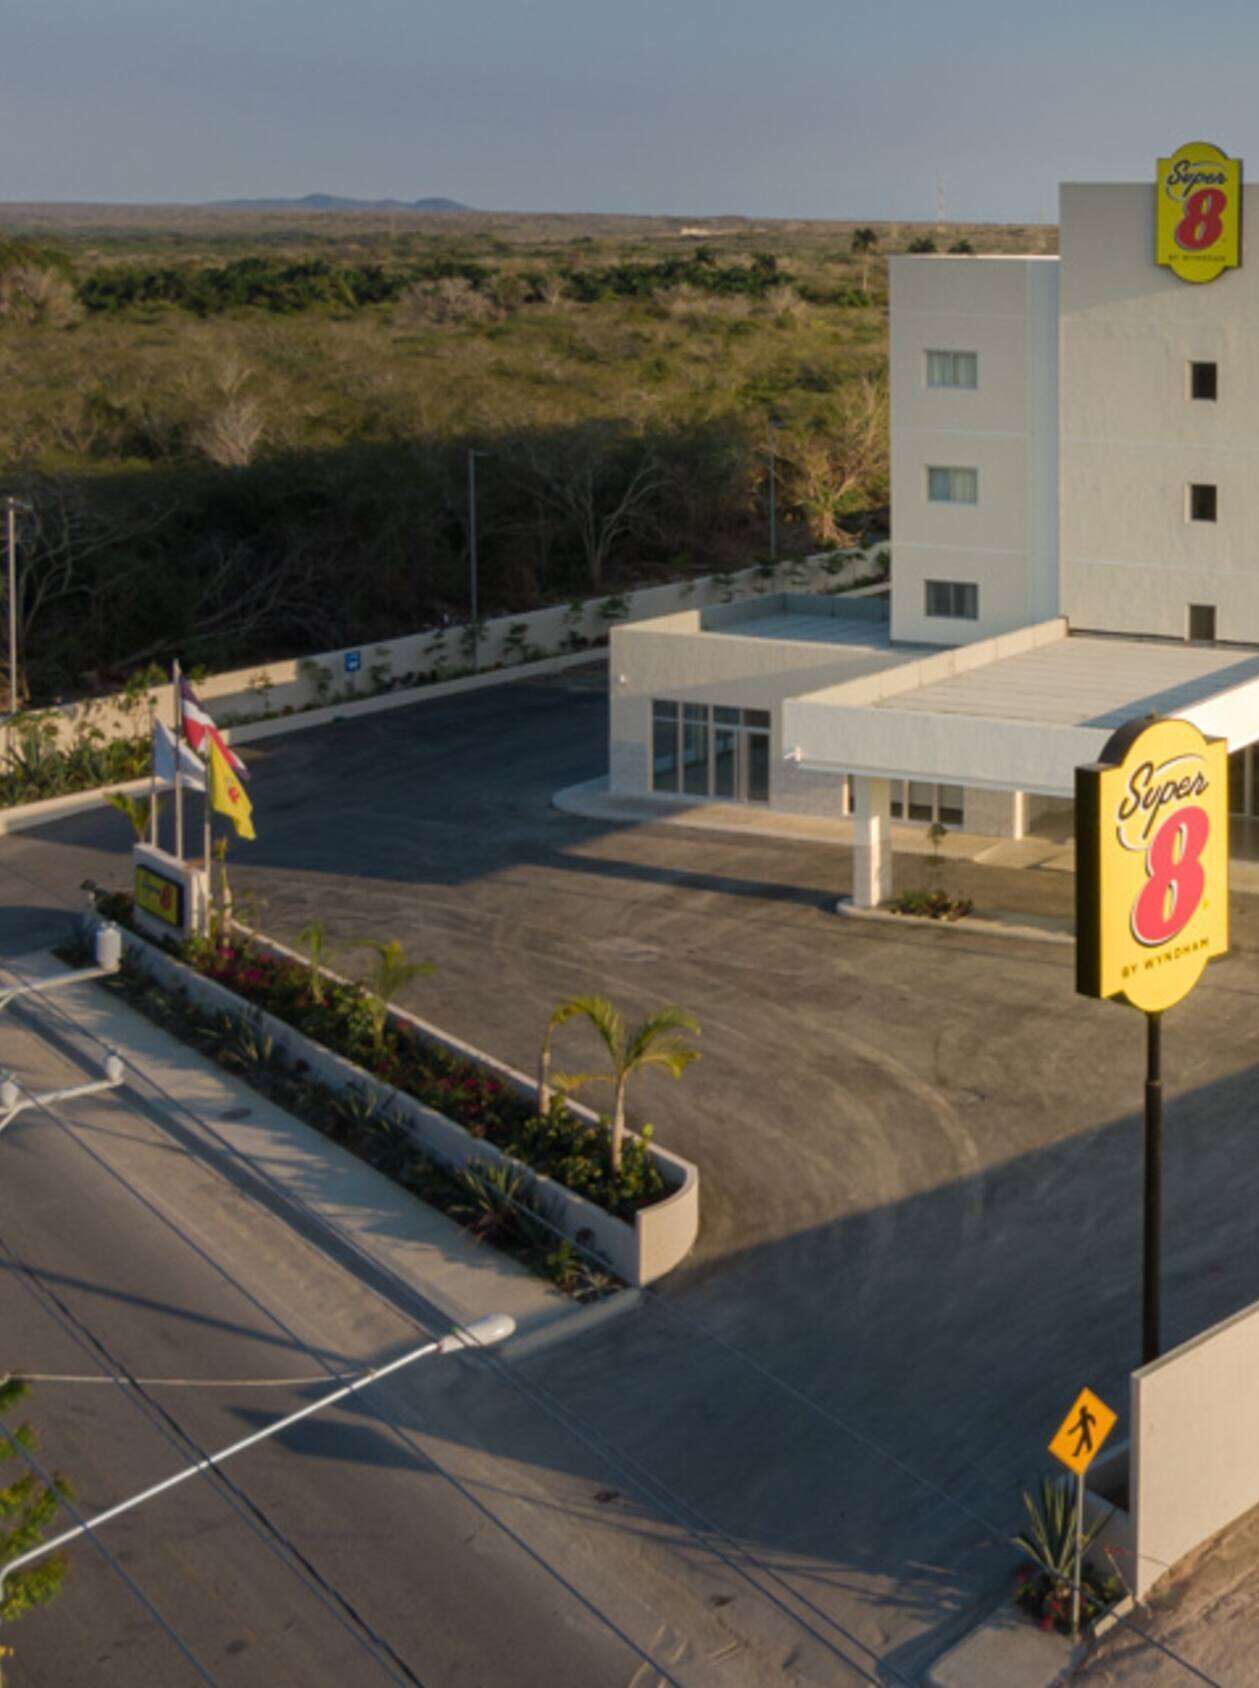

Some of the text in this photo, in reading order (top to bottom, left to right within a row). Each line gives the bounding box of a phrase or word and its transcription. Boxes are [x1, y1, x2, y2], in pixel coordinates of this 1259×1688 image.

[1167, 160, 1226, 197] Super
[1175, 187, 1227, 251] 8
[1119, 762, 1208, 839] Super
[1131, 805, 1209, 947] 8
[1121, 937, 1209, 979] BY WYNDHAM
